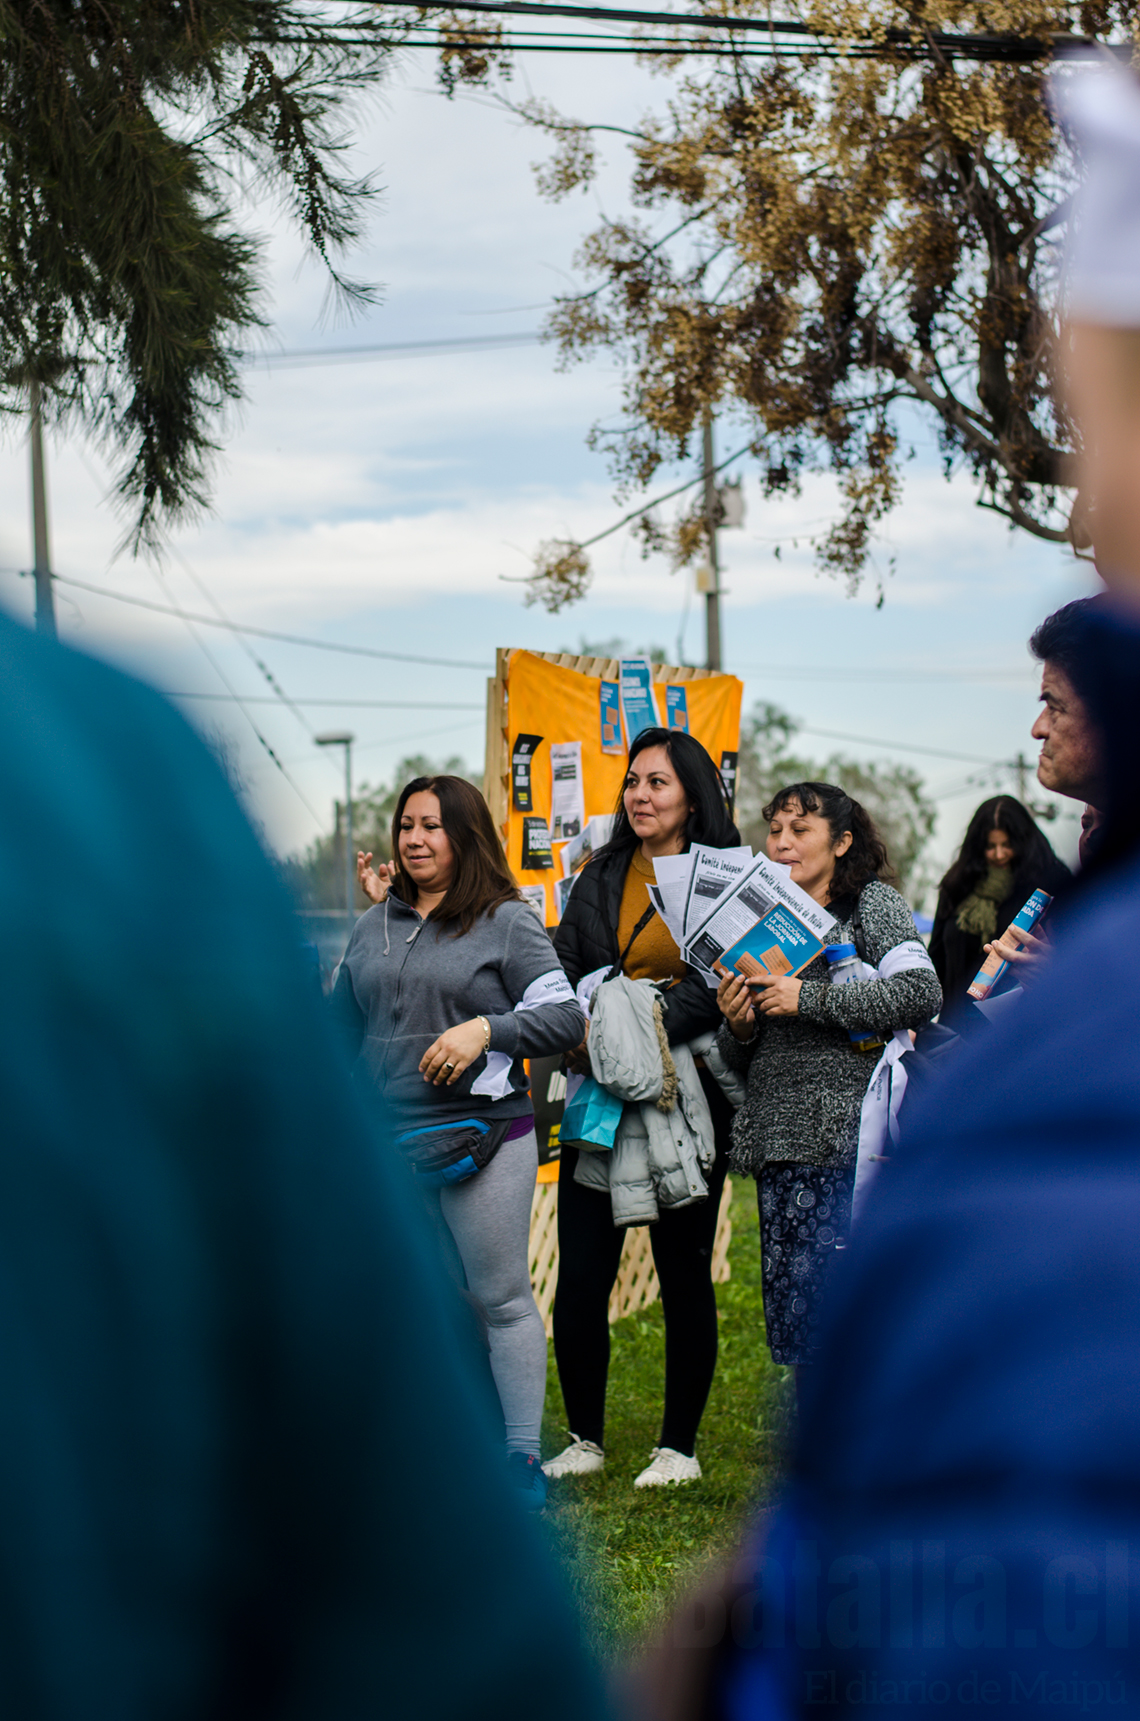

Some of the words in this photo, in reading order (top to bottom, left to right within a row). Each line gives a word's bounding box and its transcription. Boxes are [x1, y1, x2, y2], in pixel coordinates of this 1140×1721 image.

[764, 920, 786, 944] LABORAL
[768, 916, 776, 925] LA
[775, 923, 798, 947] JORNADA
[773, 911, 802, 940] REDUCCIÓN
[799, 936, 808, 946] DE
